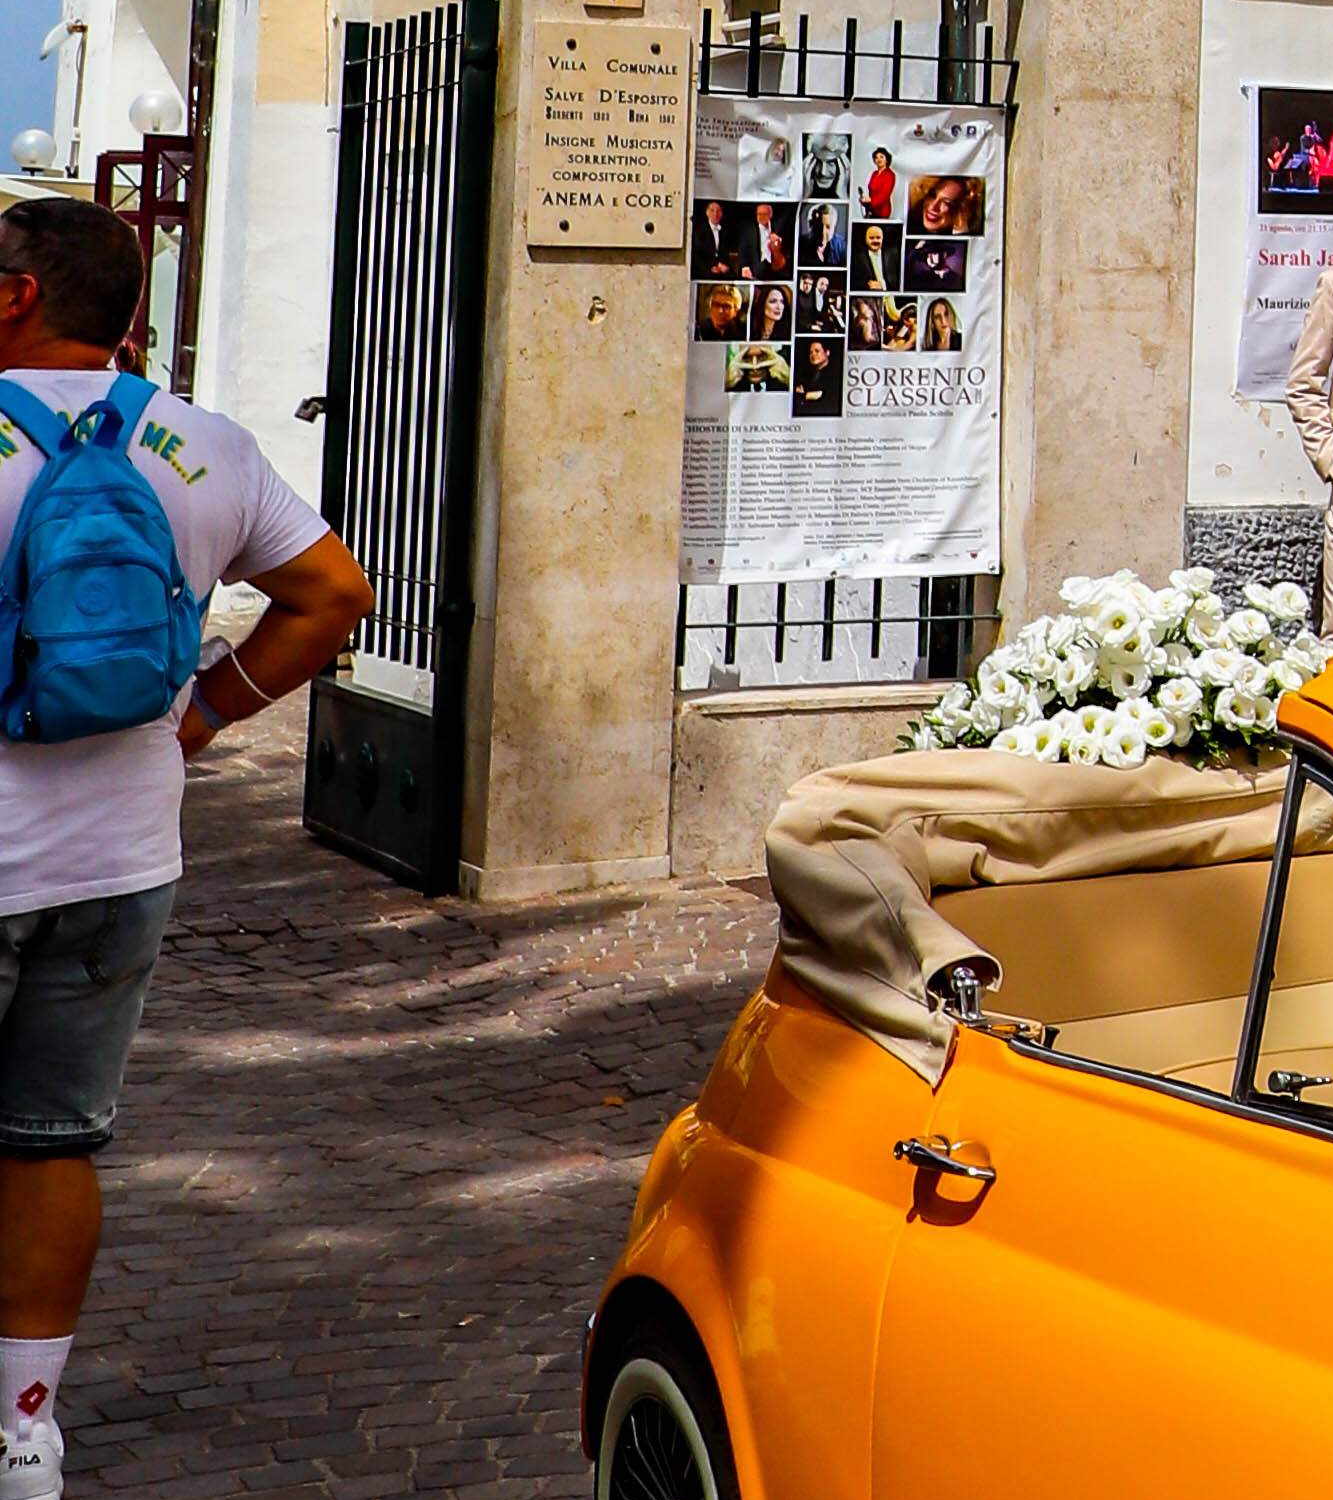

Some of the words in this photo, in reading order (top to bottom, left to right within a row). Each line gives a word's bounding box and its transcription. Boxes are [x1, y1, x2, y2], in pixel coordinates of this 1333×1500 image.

[547, 56, 587, 72] VILLA
[606, 59, 678, 76] COMUNALE
[544, 87, 585, 102] SALVE
[599, 89, 679, 106] D'ESPOSITO
[545, 132, 596, 148] INSIGNE
[606, 135, 674, 151] MUSICISTA
[552, 171, 642, 184] COMPOSITORE
[651, 173, 665, 184] DI
[1257, 248, 1311, 267] Sarah
[1257, 296, 1310, 310] Maurizio
[847, 366, 986, 388] SORRENTO
[847, 386, 973, 407] CLASSICA
[9, 1453, 41, 1470] FILA
